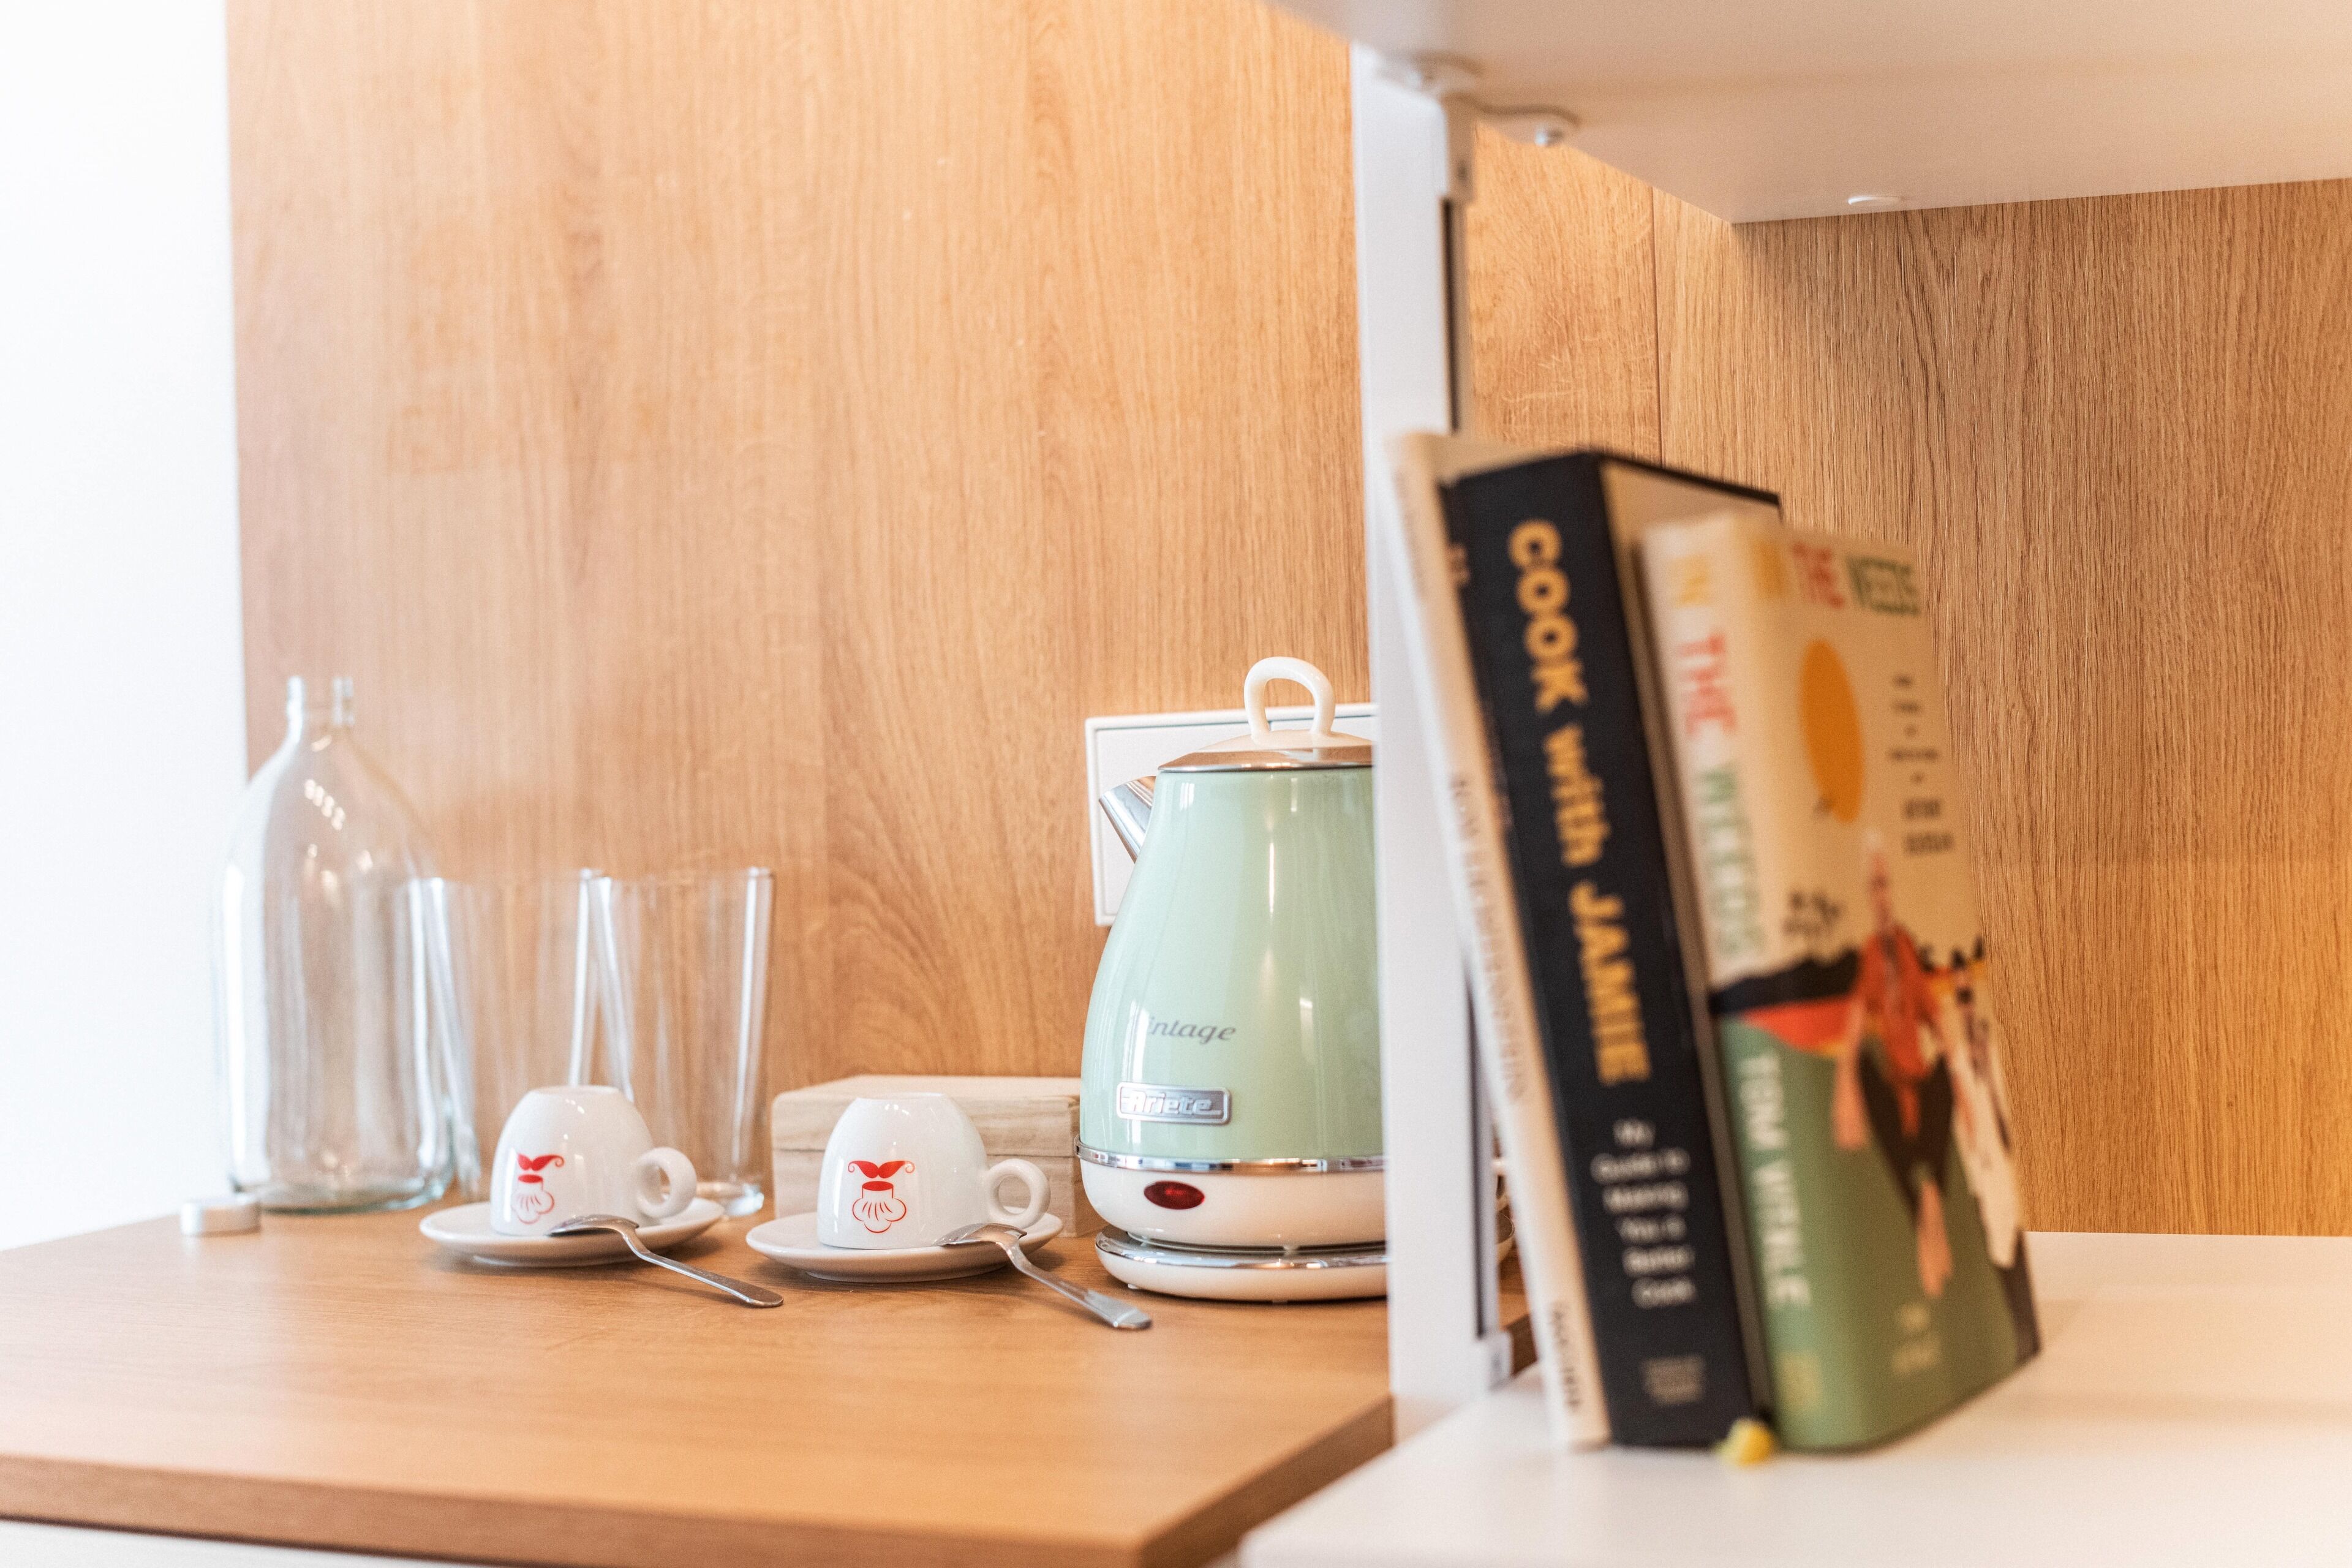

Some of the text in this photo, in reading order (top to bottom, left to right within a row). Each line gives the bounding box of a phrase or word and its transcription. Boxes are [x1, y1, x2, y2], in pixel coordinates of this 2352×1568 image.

[1792, 542, 1846, 611] THE
[1678, 631, 1738, 739] THE
[1509, 518, 1651, 1087] COOK with JAMIE
[1692, 763, 1765, 957] WEEDS
[1613, 1118, 1654, 1149] My
[1737, 1055, 1791, 1150] TOM
[1591, 1153, 1657, 1185] Guide
[1630, 1276, 1697, 1310] Cook
